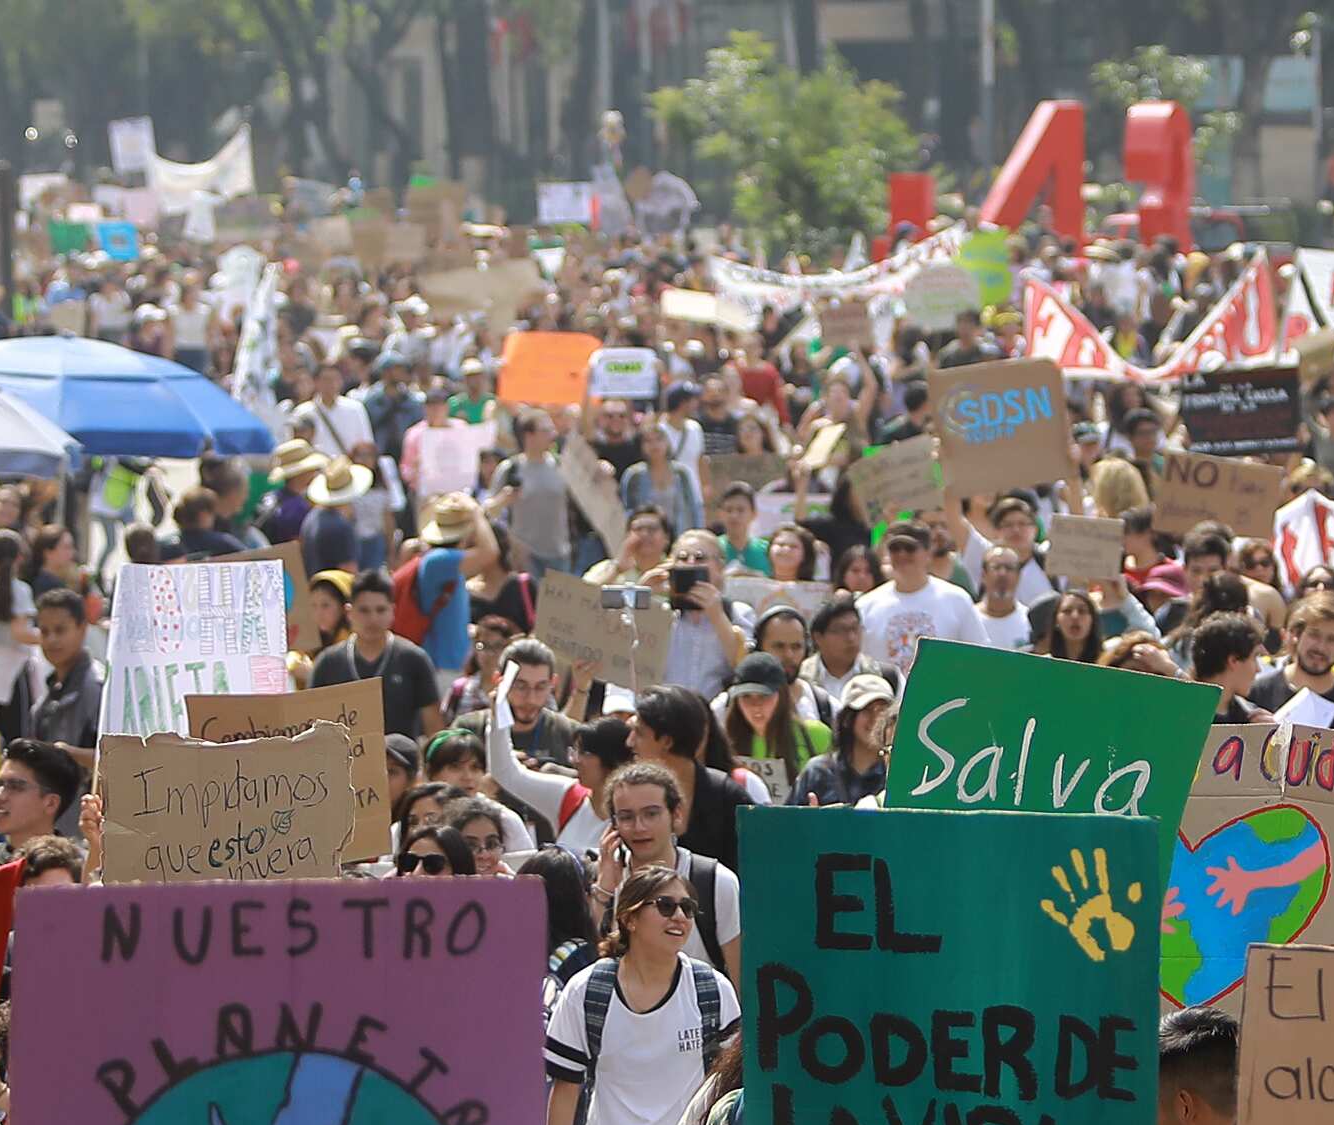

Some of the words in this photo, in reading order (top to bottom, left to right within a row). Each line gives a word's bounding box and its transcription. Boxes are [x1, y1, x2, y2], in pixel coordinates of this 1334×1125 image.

[958, 384, 1054, 430] SDSN
[911, 697, 1153, 816] Salva
[208, 821, 267, 868] esto
[100, 899, 488, 965] NUESTRO
[814, 852, 943, 954] EL
[1264, 953, 1325, 1023] El
[678, 1028, 701, 1041] LATE
[678, 1041, 701, 1052] HATE
[755, 962, 1038, 1102] PODER
[1055, 1014, 1139, 1102] DE
